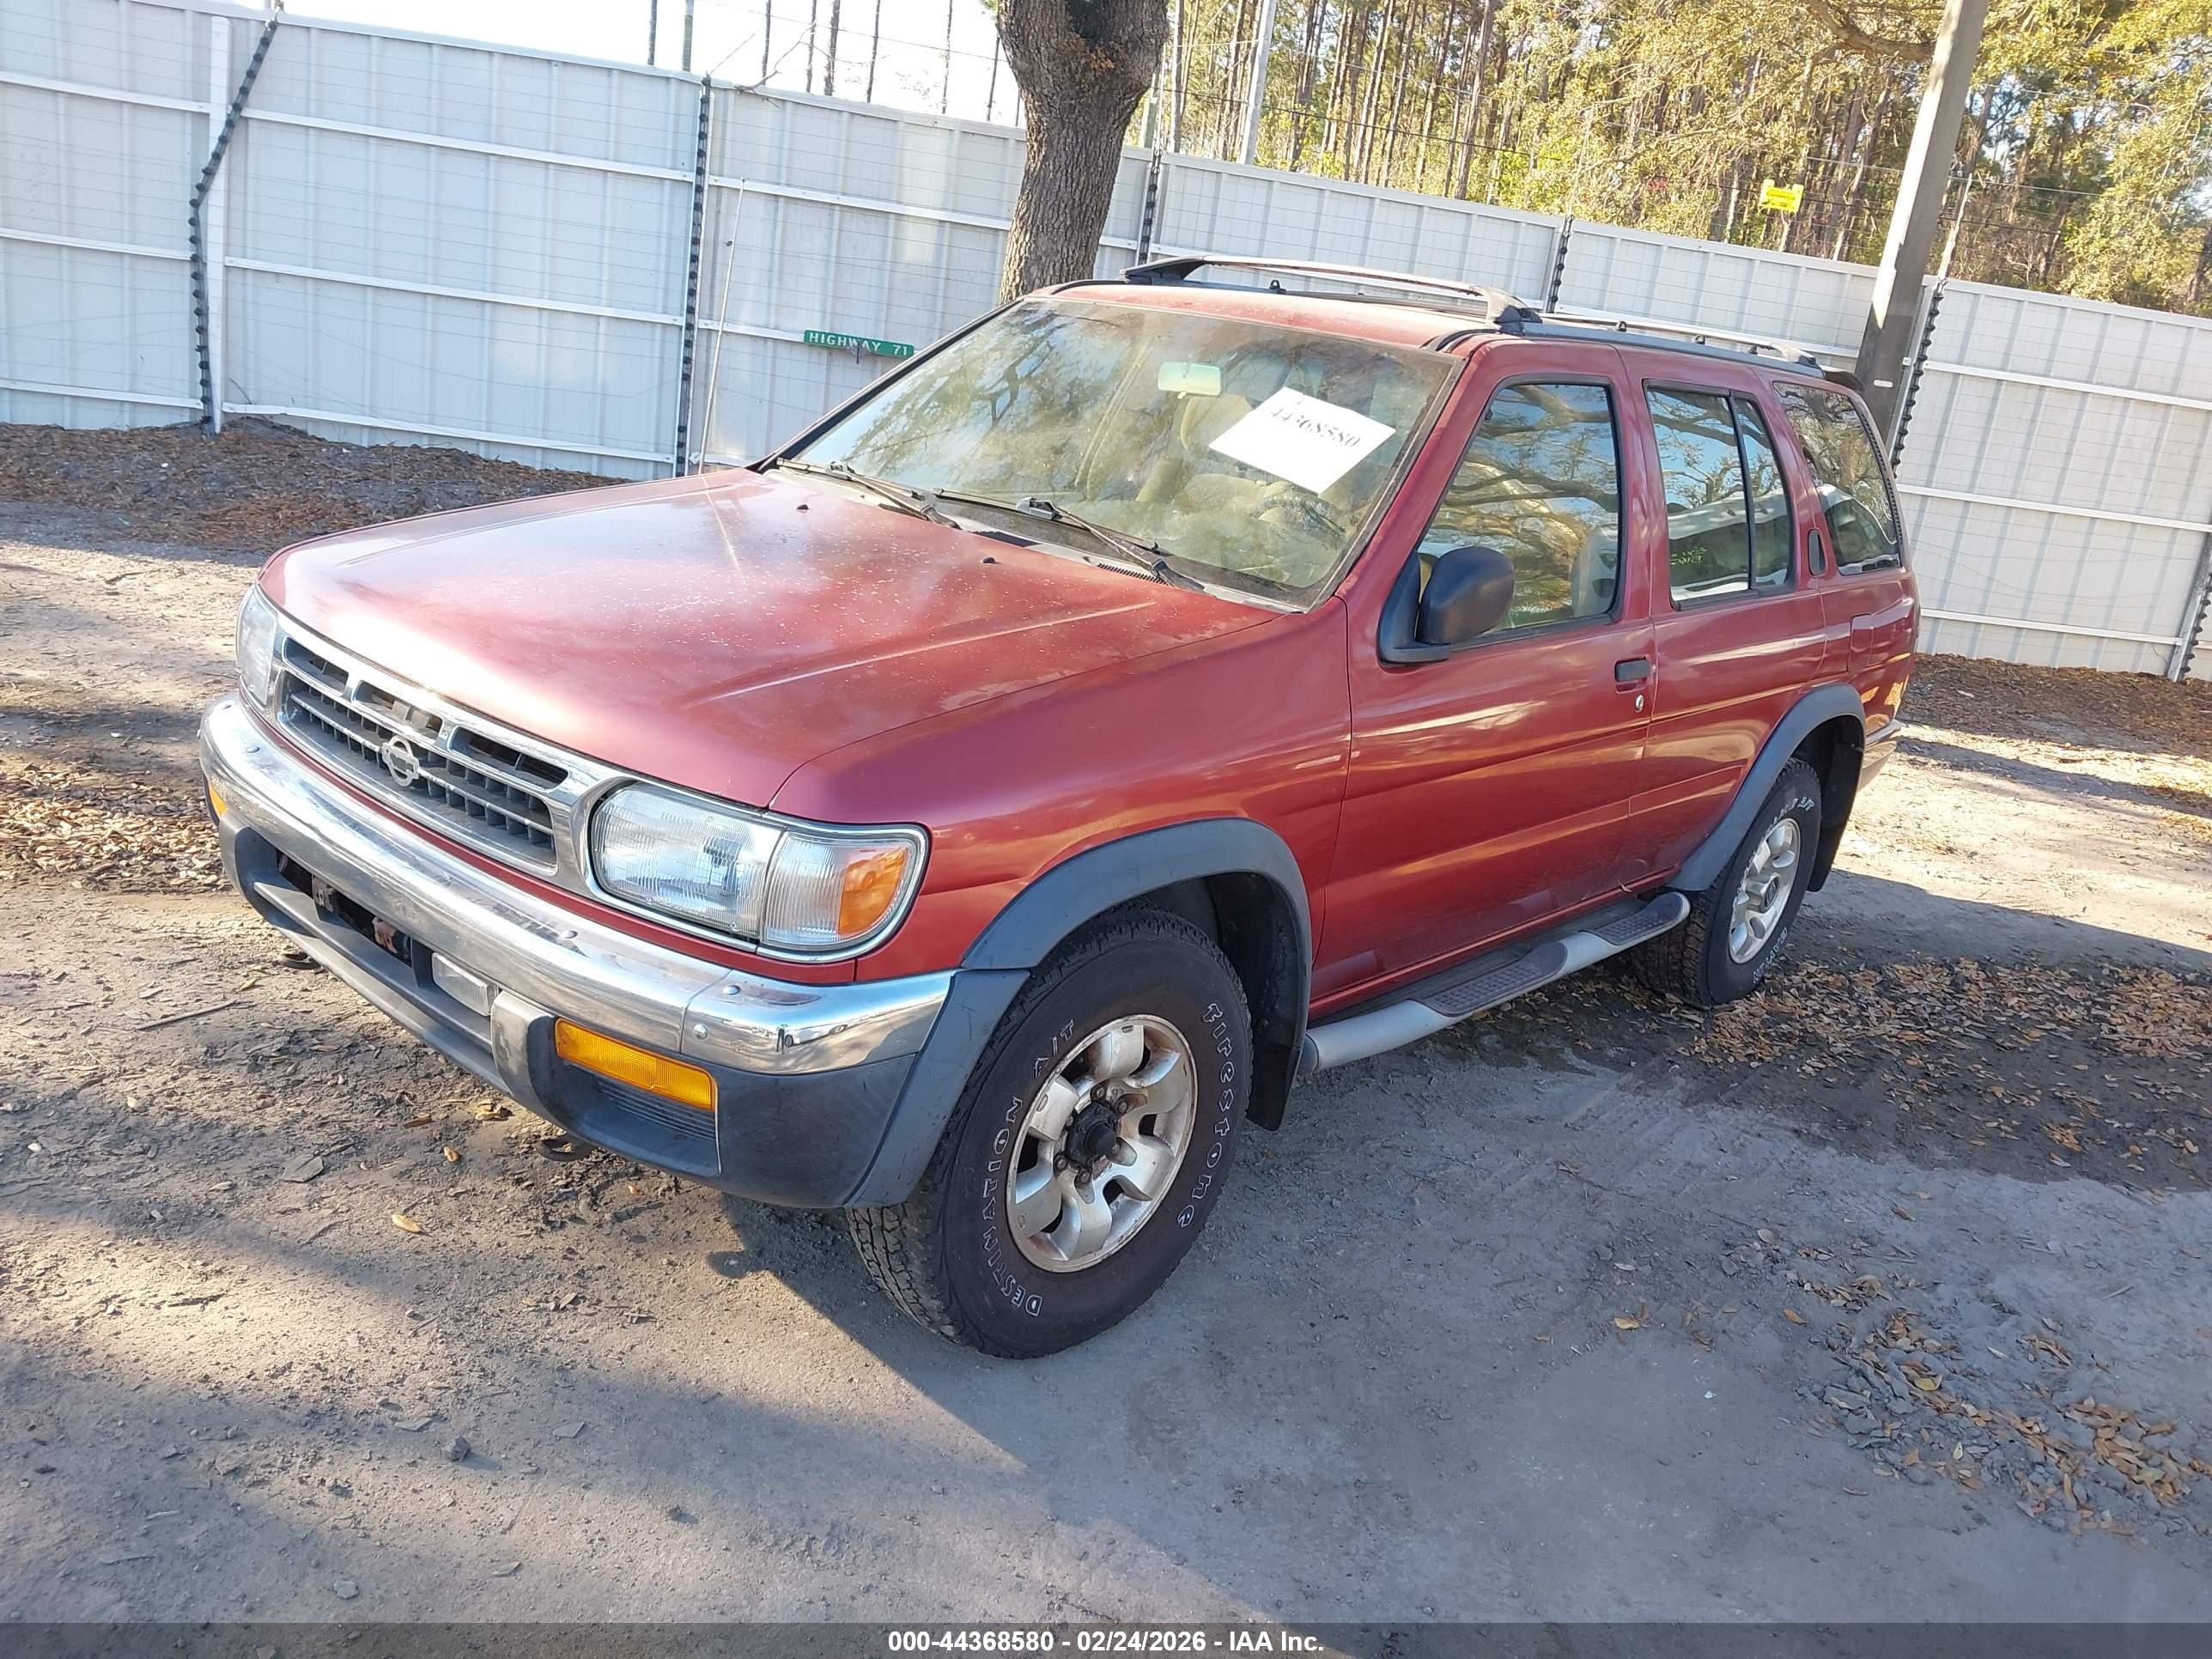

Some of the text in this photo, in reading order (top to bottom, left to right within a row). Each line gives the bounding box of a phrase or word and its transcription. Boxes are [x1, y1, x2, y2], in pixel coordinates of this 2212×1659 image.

[809, 331, 908, 356] HIGHWAY 71
[981, 1097, 1043, 1317] DESTINATION
